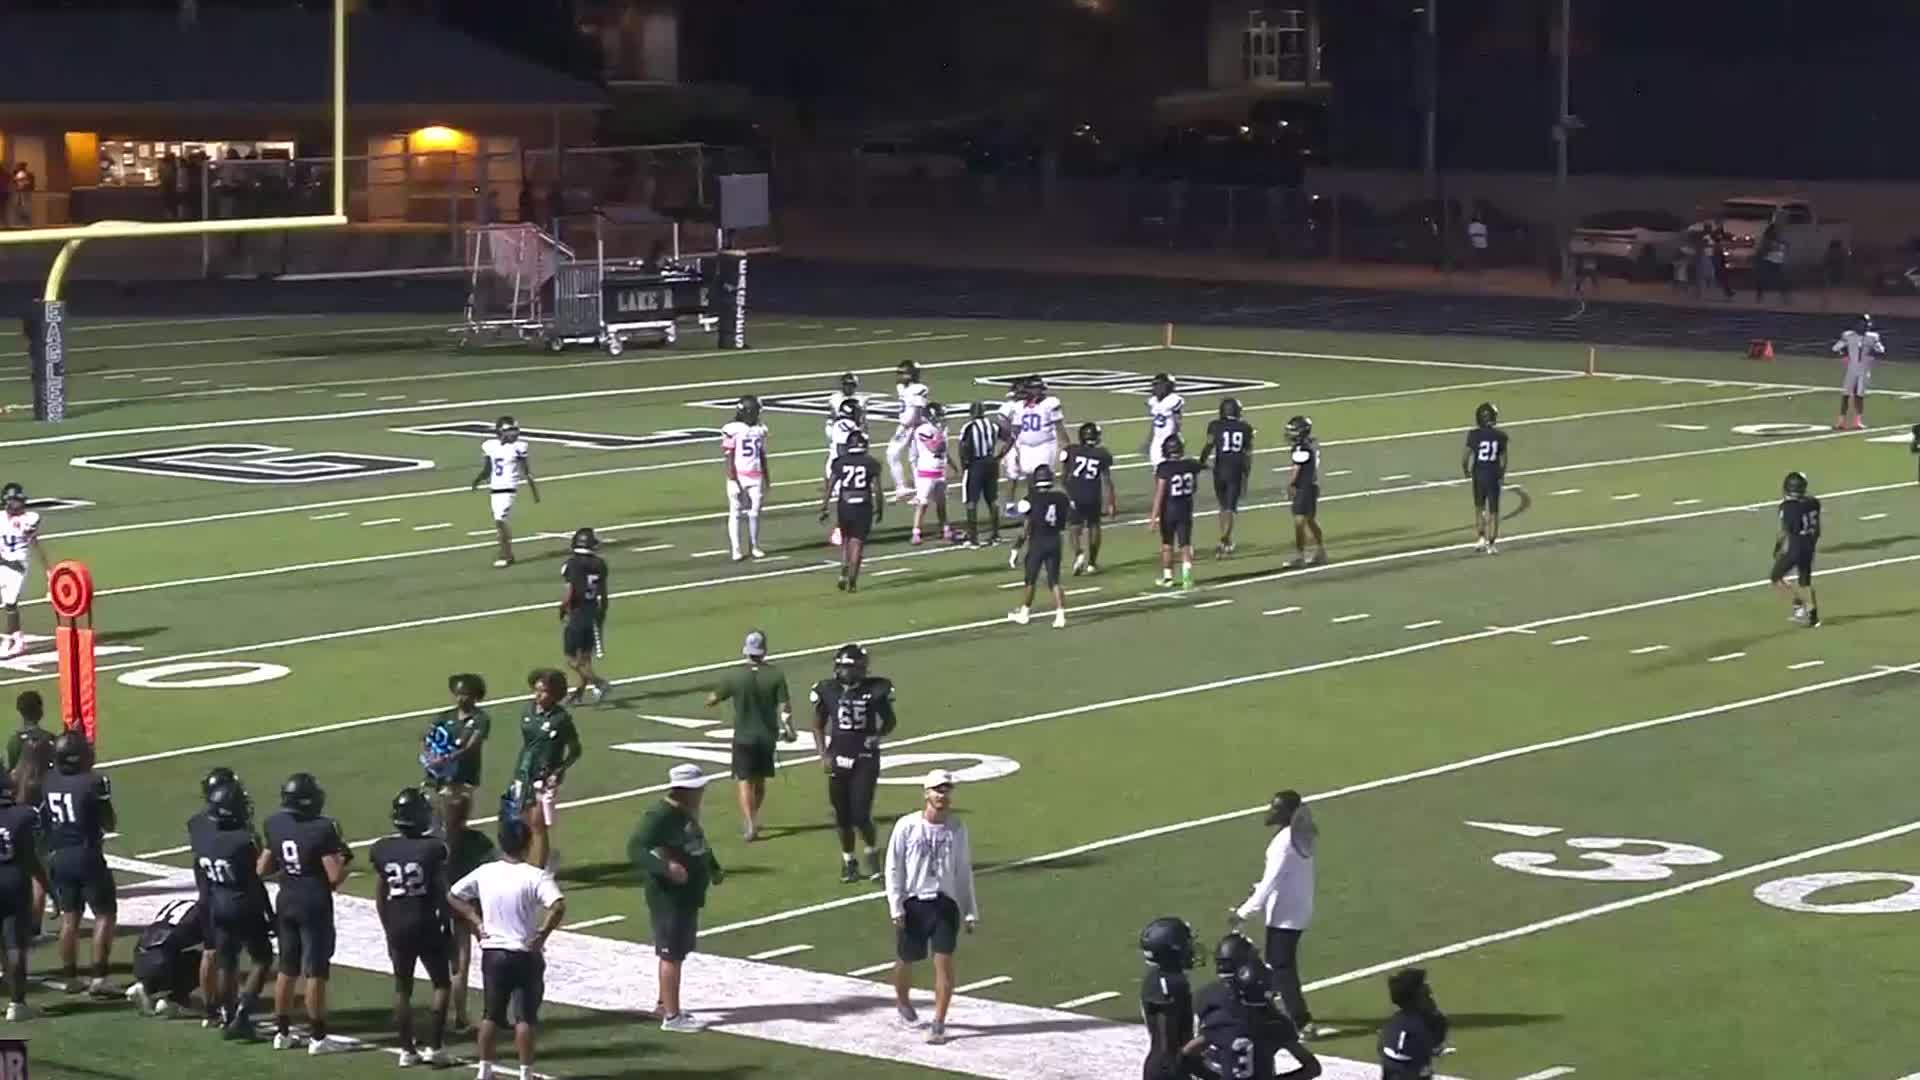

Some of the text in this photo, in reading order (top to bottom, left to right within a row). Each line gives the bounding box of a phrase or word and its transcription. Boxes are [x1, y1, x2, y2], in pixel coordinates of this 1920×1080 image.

[617, 289, 658, 312] LAKE
[735, 259, 747, 348] EAGLES
[45, 302, 64, 423] EAGLES
[1222, 431, 1243, 452] 19
[1478, 441, 1498, 461] 21
[842, 465, 866, 488] 72
[1073, 456, 1099, 479] 75
[1171, 473, 1193, 496] 23
[1045, 504, 1057, 527] 4
[584, 575, 598, 599] 5
[838, 706, 867, 730] 65
[48, 792, 76, 823] 51
[282, 840, 301, 875] 9
[384, 862, 427, 897] 22
[1231, 1036, 1254, 1079] 3
